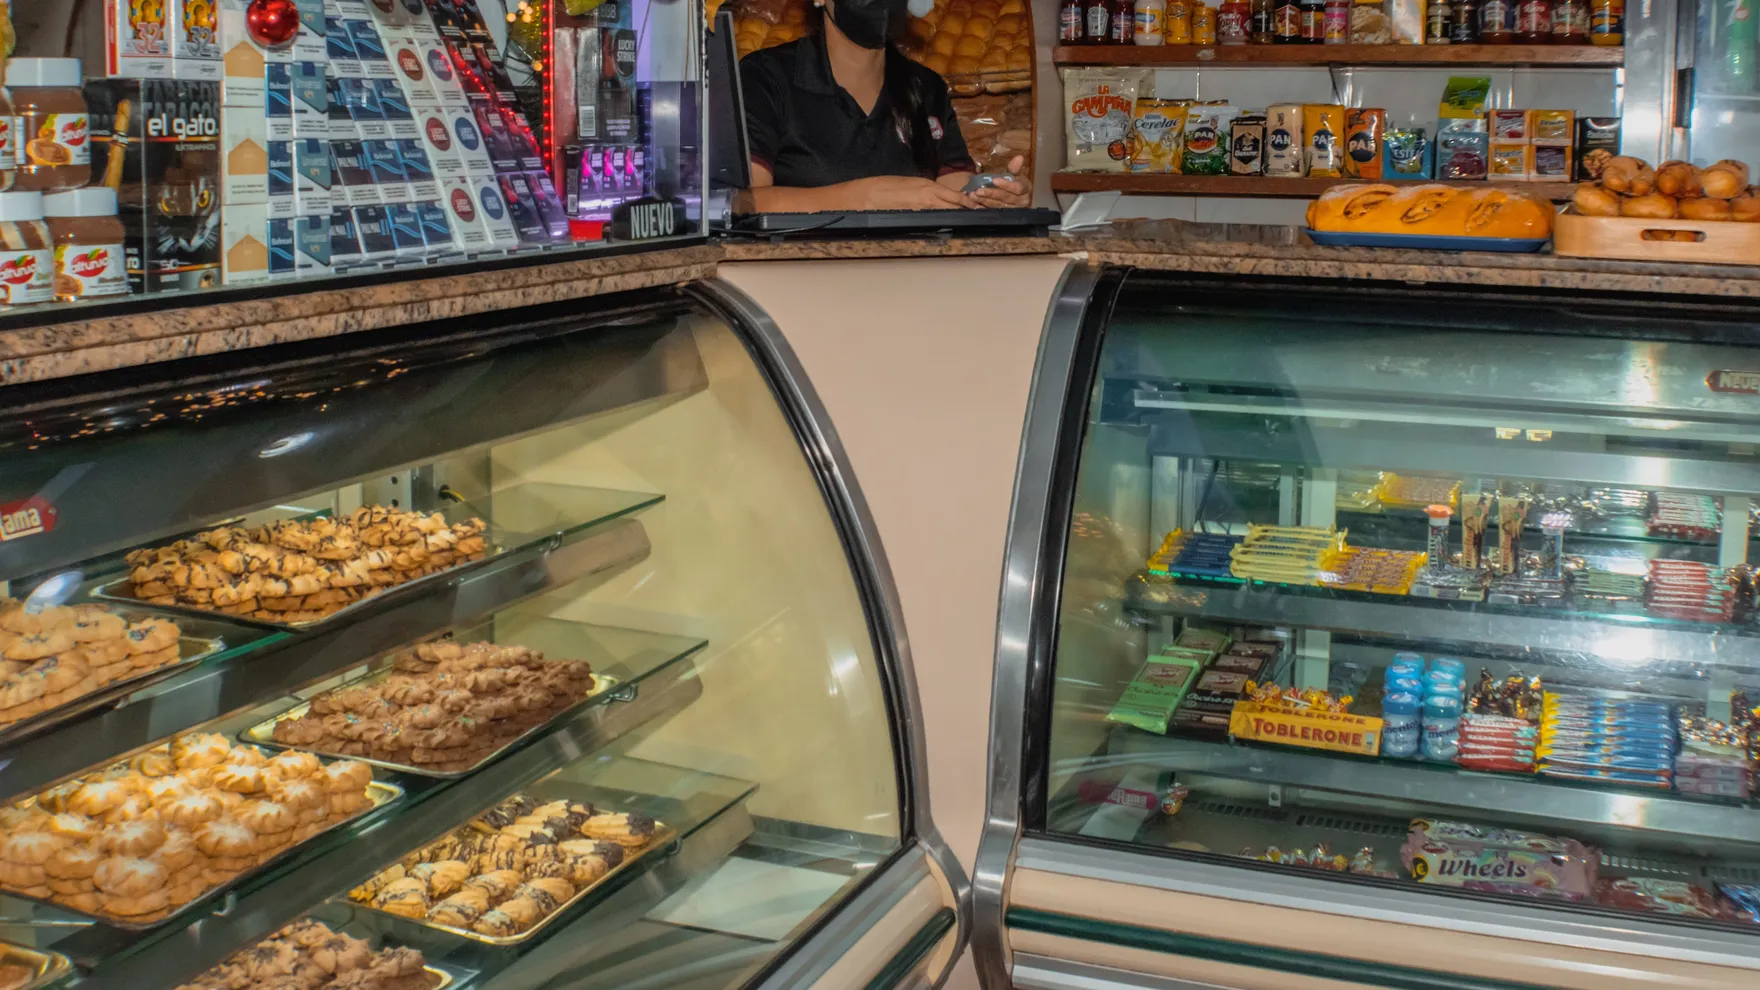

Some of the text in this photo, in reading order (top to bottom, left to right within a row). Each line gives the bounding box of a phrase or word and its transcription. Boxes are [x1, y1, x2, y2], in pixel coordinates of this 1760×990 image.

[618, 39, 636, 50] LUCKY
[617, 51, 636, 62] STRIKE
[1097, 85, 1110, 95] LA
[148, 113, 216, 141] el gato
[630, 202, 674, 239] NUEVO
[1259, 705, 1367, 725] TOBLERONE
[1253, 717, 1362, 747] TOBLERONE
[1438, 859, 1528, 879] Wheels
